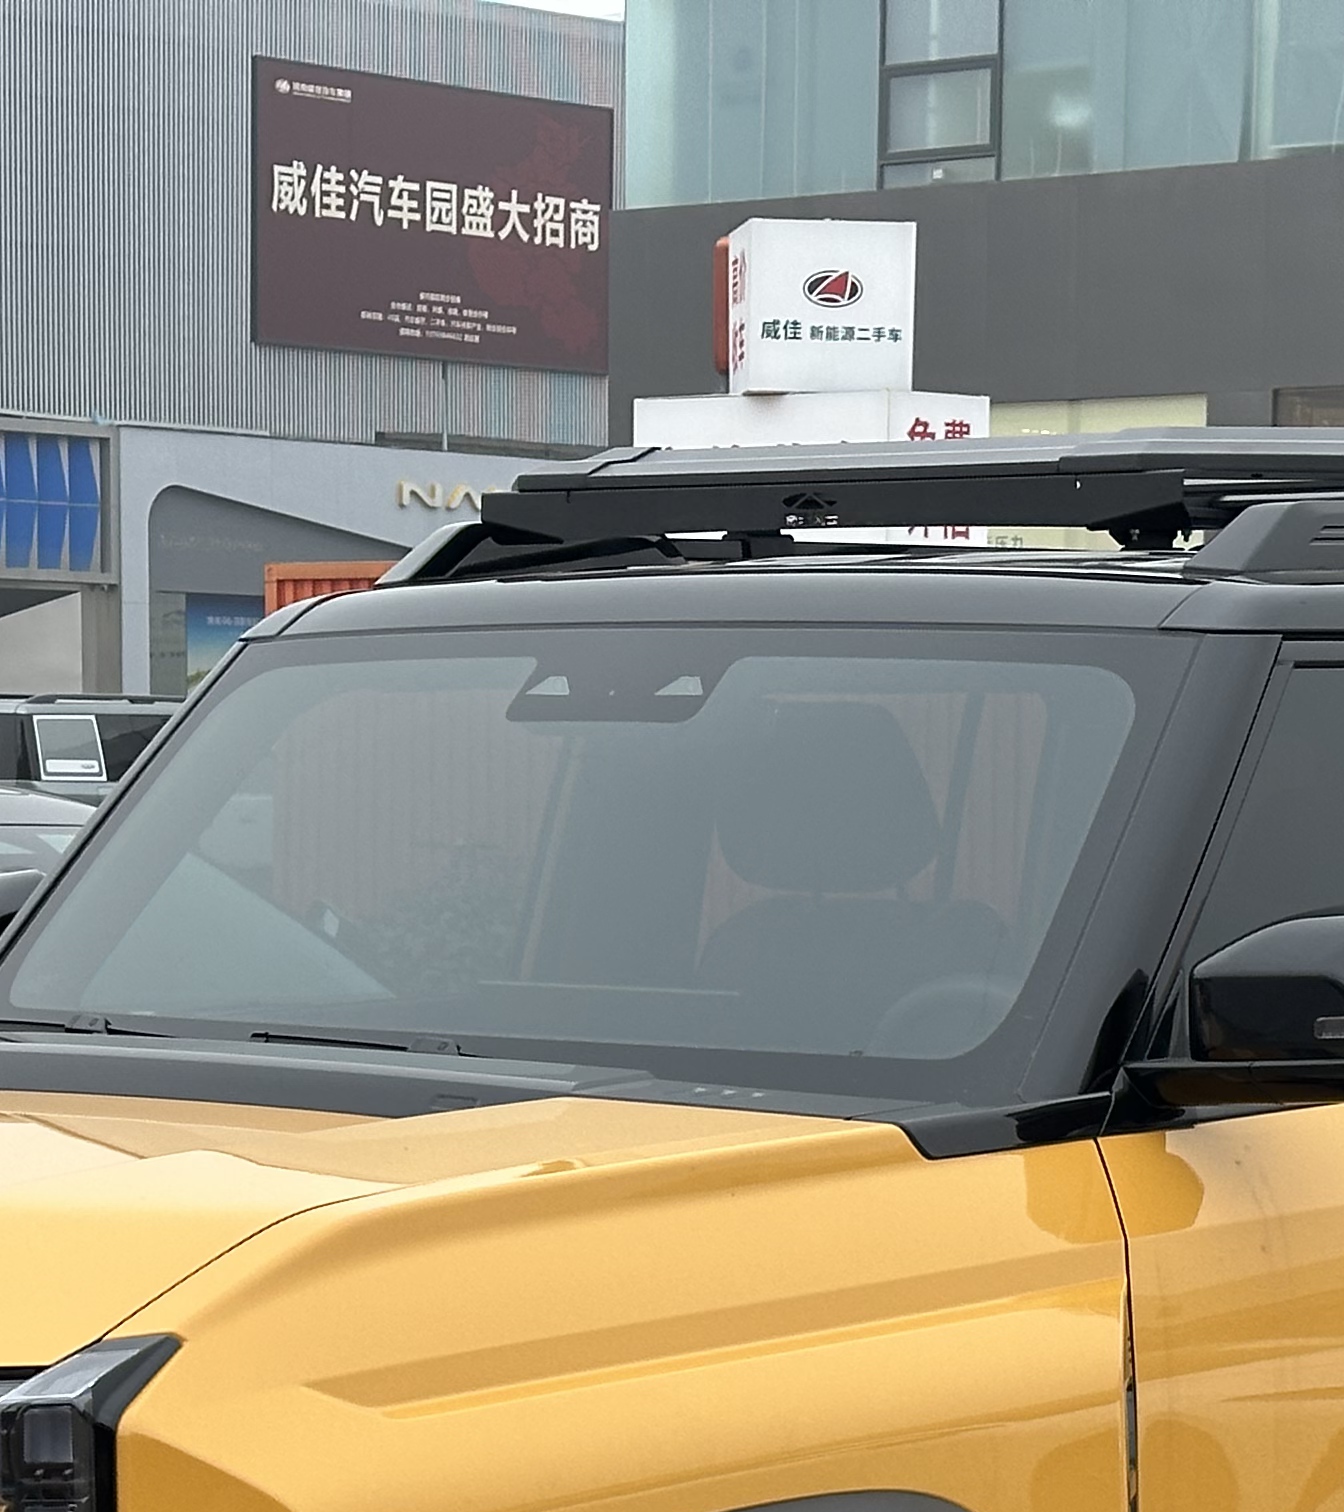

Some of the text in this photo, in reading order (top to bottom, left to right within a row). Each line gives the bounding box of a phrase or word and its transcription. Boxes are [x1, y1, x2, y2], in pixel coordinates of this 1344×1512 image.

[272, 161, 600, 252] 威佳汽车园盛大招商
[761, 319, 903, 343] 威佳 新能源二手车
